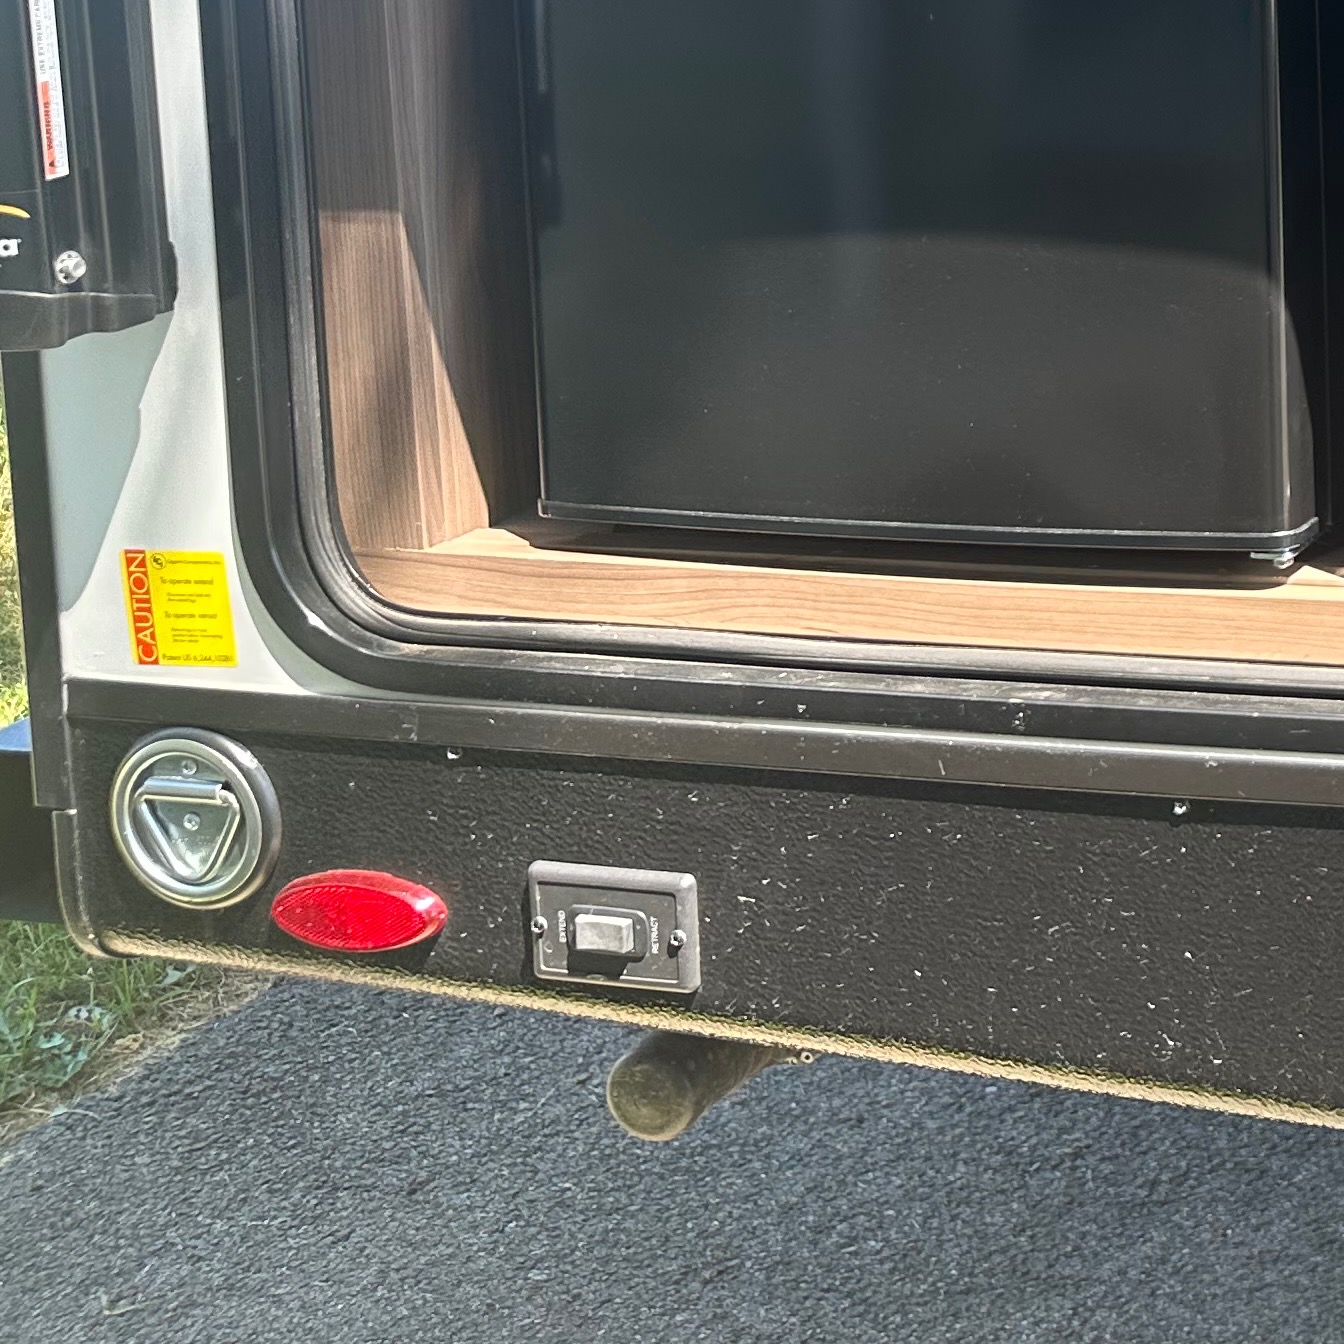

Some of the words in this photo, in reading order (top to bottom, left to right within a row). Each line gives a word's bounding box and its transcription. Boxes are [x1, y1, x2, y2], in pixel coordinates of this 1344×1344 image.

[126, 552, 158, 662] CAUTION
[558, 910, 567, 943] EXTEND
[650, 916, 659, 954] RETRACT
